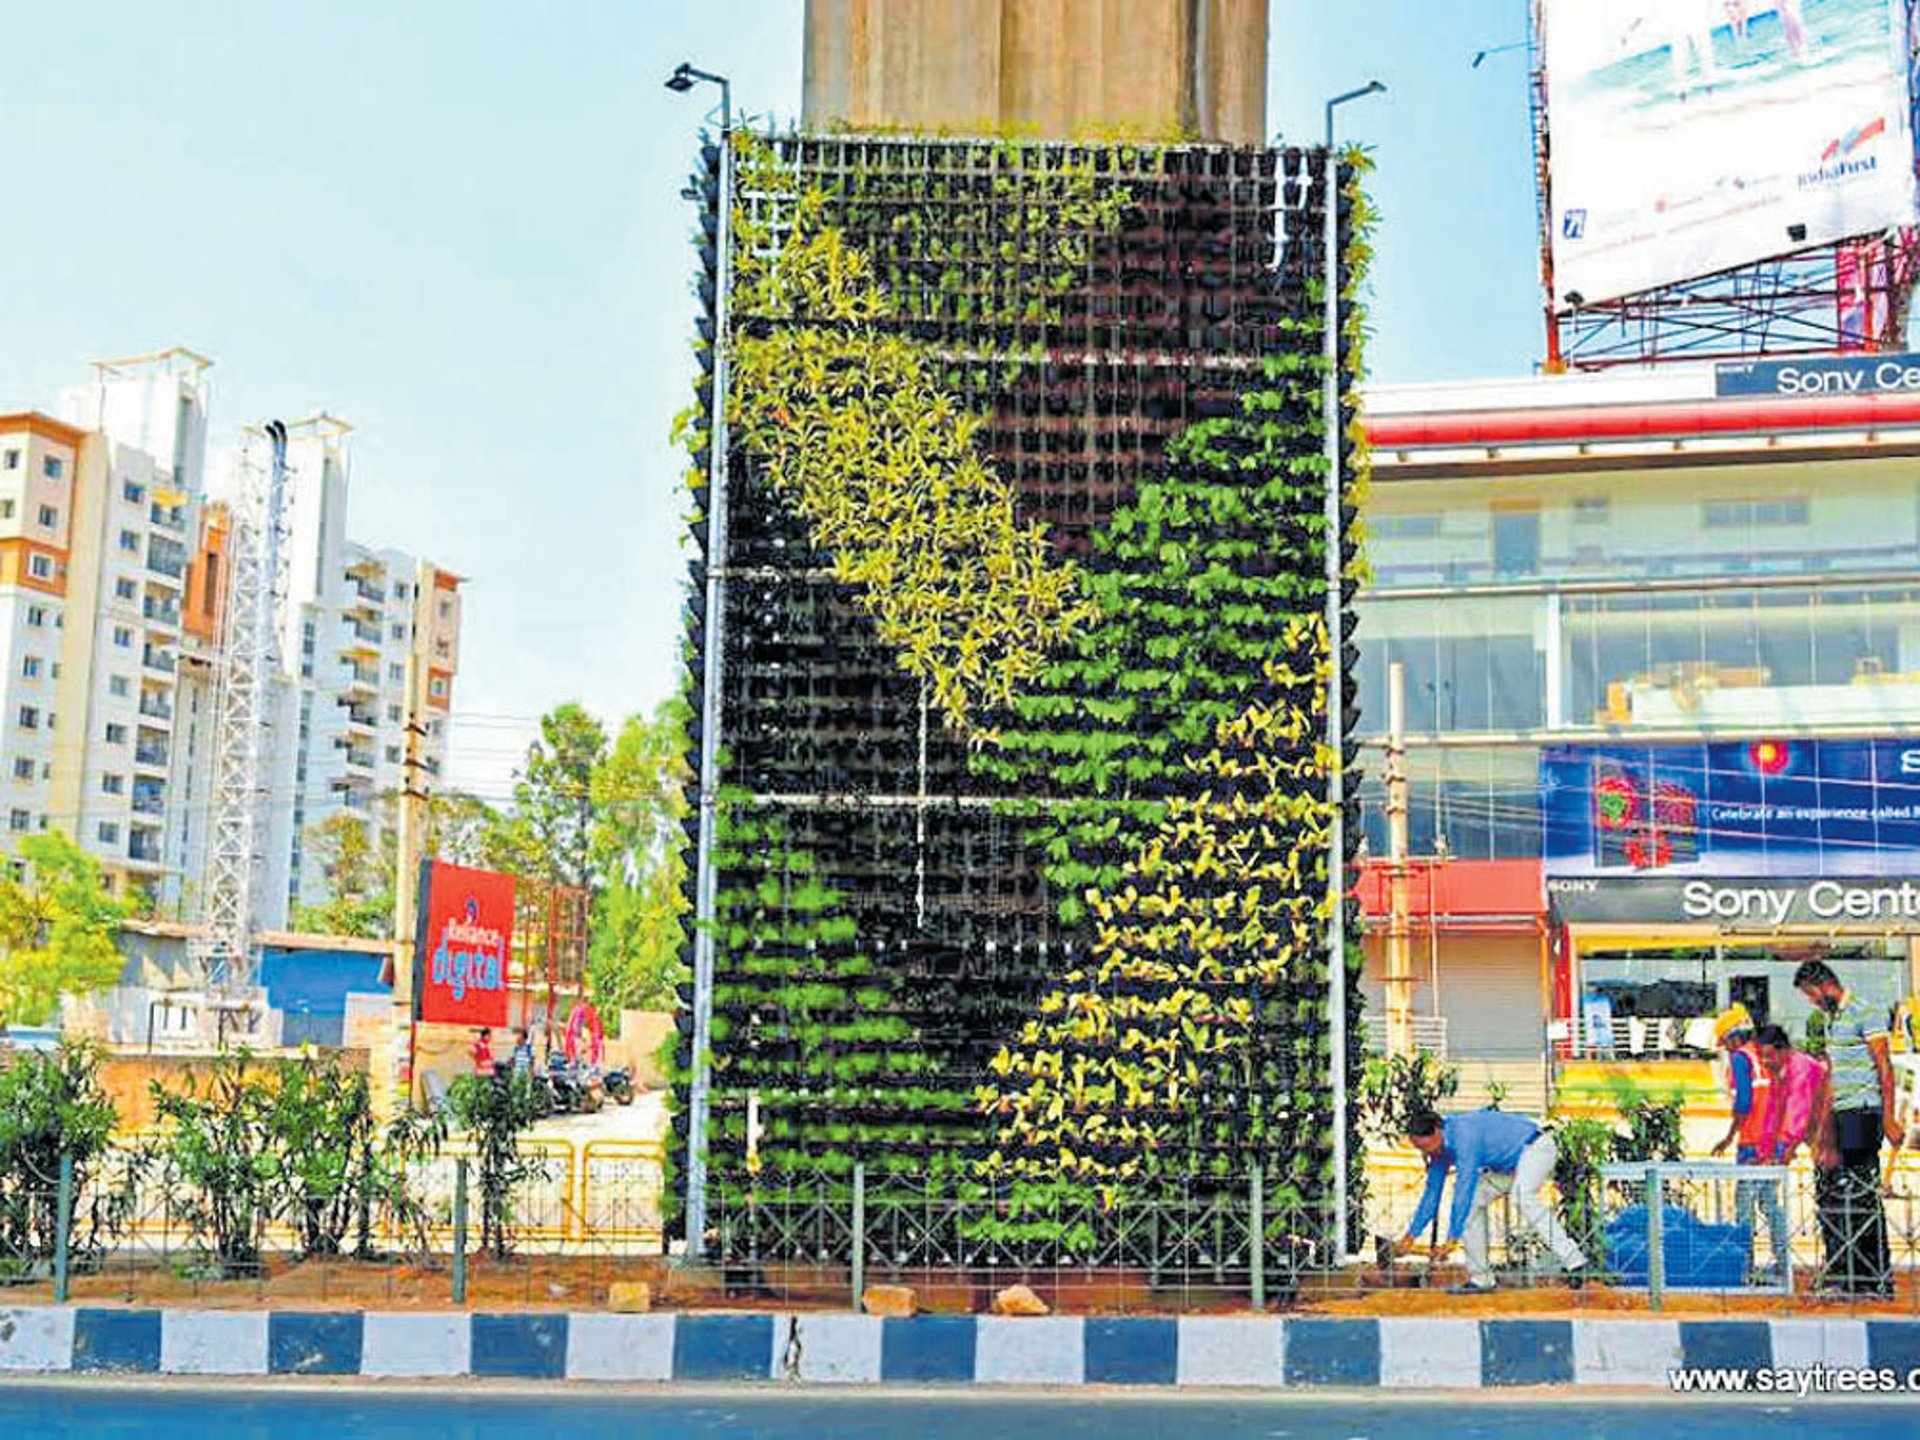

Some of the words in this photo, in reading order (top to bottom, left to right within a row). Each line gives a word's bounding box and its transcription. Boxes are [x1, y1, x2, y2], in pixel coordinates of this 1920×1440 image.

[1712, 805, 1774, 821] Celebrate
[1683, 881, 1796, 924] Sony
[1808, 880, 1920, 917] Cent
[433, 928, 504, 1002] digital
